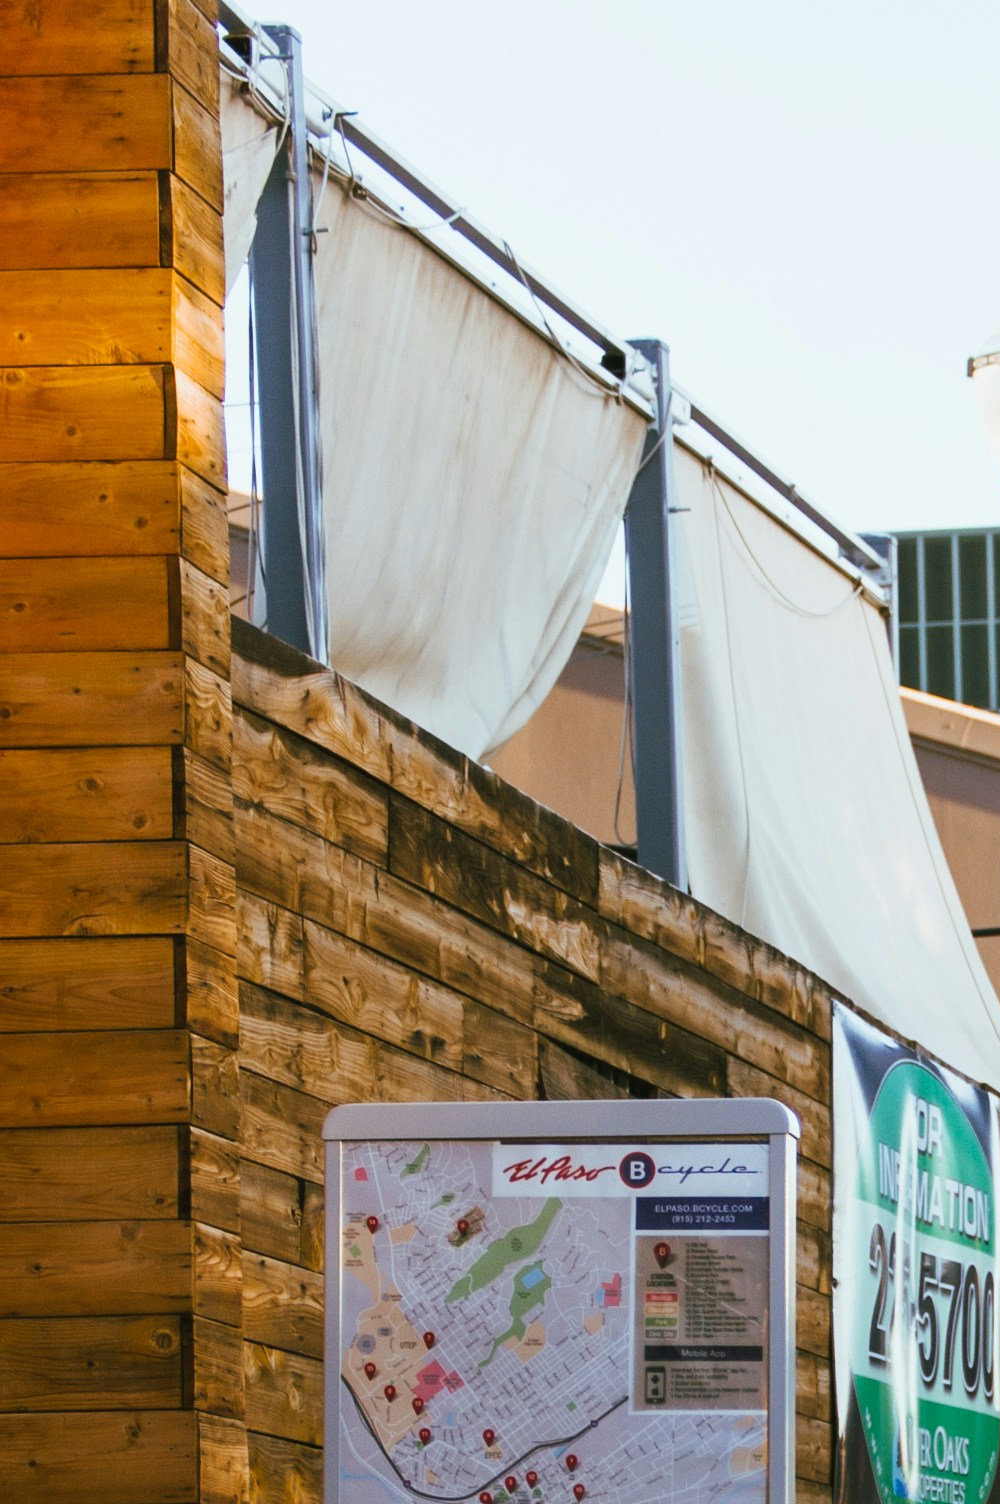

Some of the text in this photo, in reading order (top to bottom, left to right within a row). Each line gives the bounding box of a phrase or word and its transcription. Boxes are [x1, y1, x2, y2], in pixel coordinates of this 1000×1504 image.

[909, 1092, 946, 1157] OR
[540, 1156, 617, 1184] Paso
[879, 1141, 990, 1243] INFMATION
[654, 1204, 753, 1213] ELPASO.BCYCLE.COM
[671, 1215, 694, 1224] (915)
[868, 1223, 994, 1400] 2-5700
[400, 1341, 417, 1349] UTEP
[680, 1349, 726, 1359] Mobile App
[485, 1452, 502, 1460] EPCC
